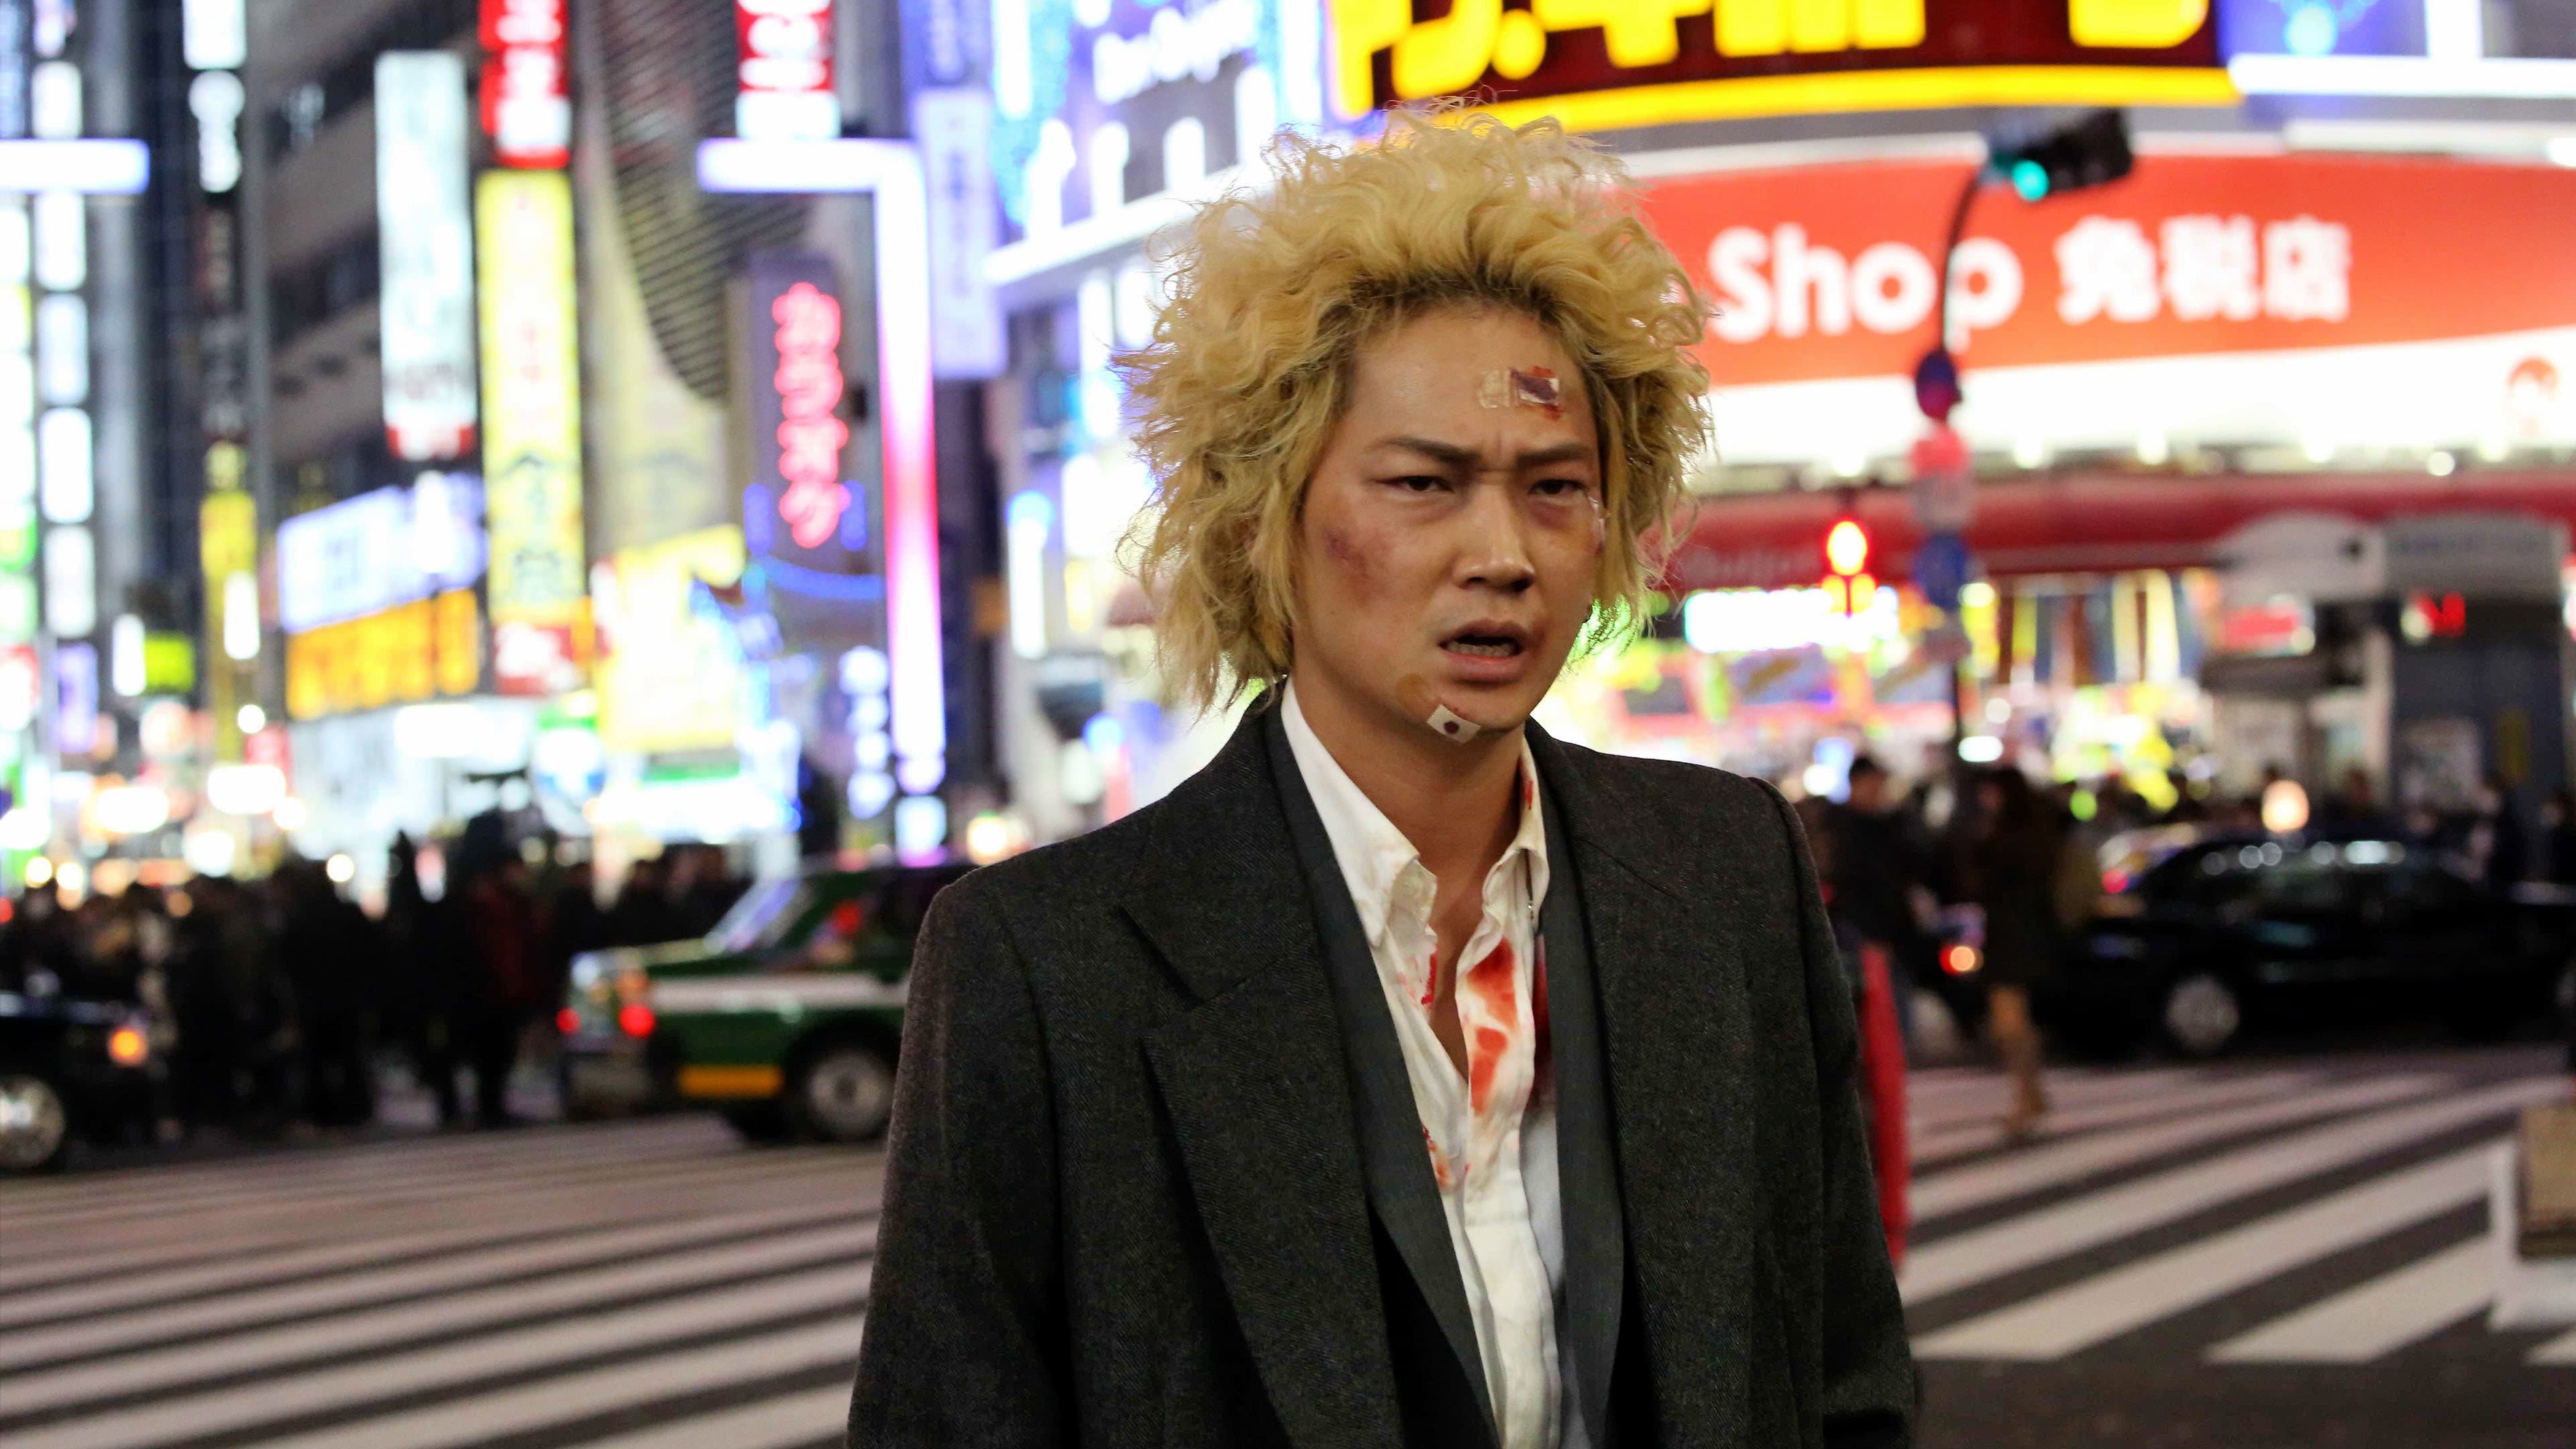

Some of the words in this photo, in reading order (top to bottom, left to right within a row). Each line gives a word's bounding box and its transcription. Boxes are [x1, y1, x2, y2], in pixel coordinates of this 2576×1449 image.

[1707, 223, 2023, 353] Shop
[2054, 214, 2352, 325] 免税店
